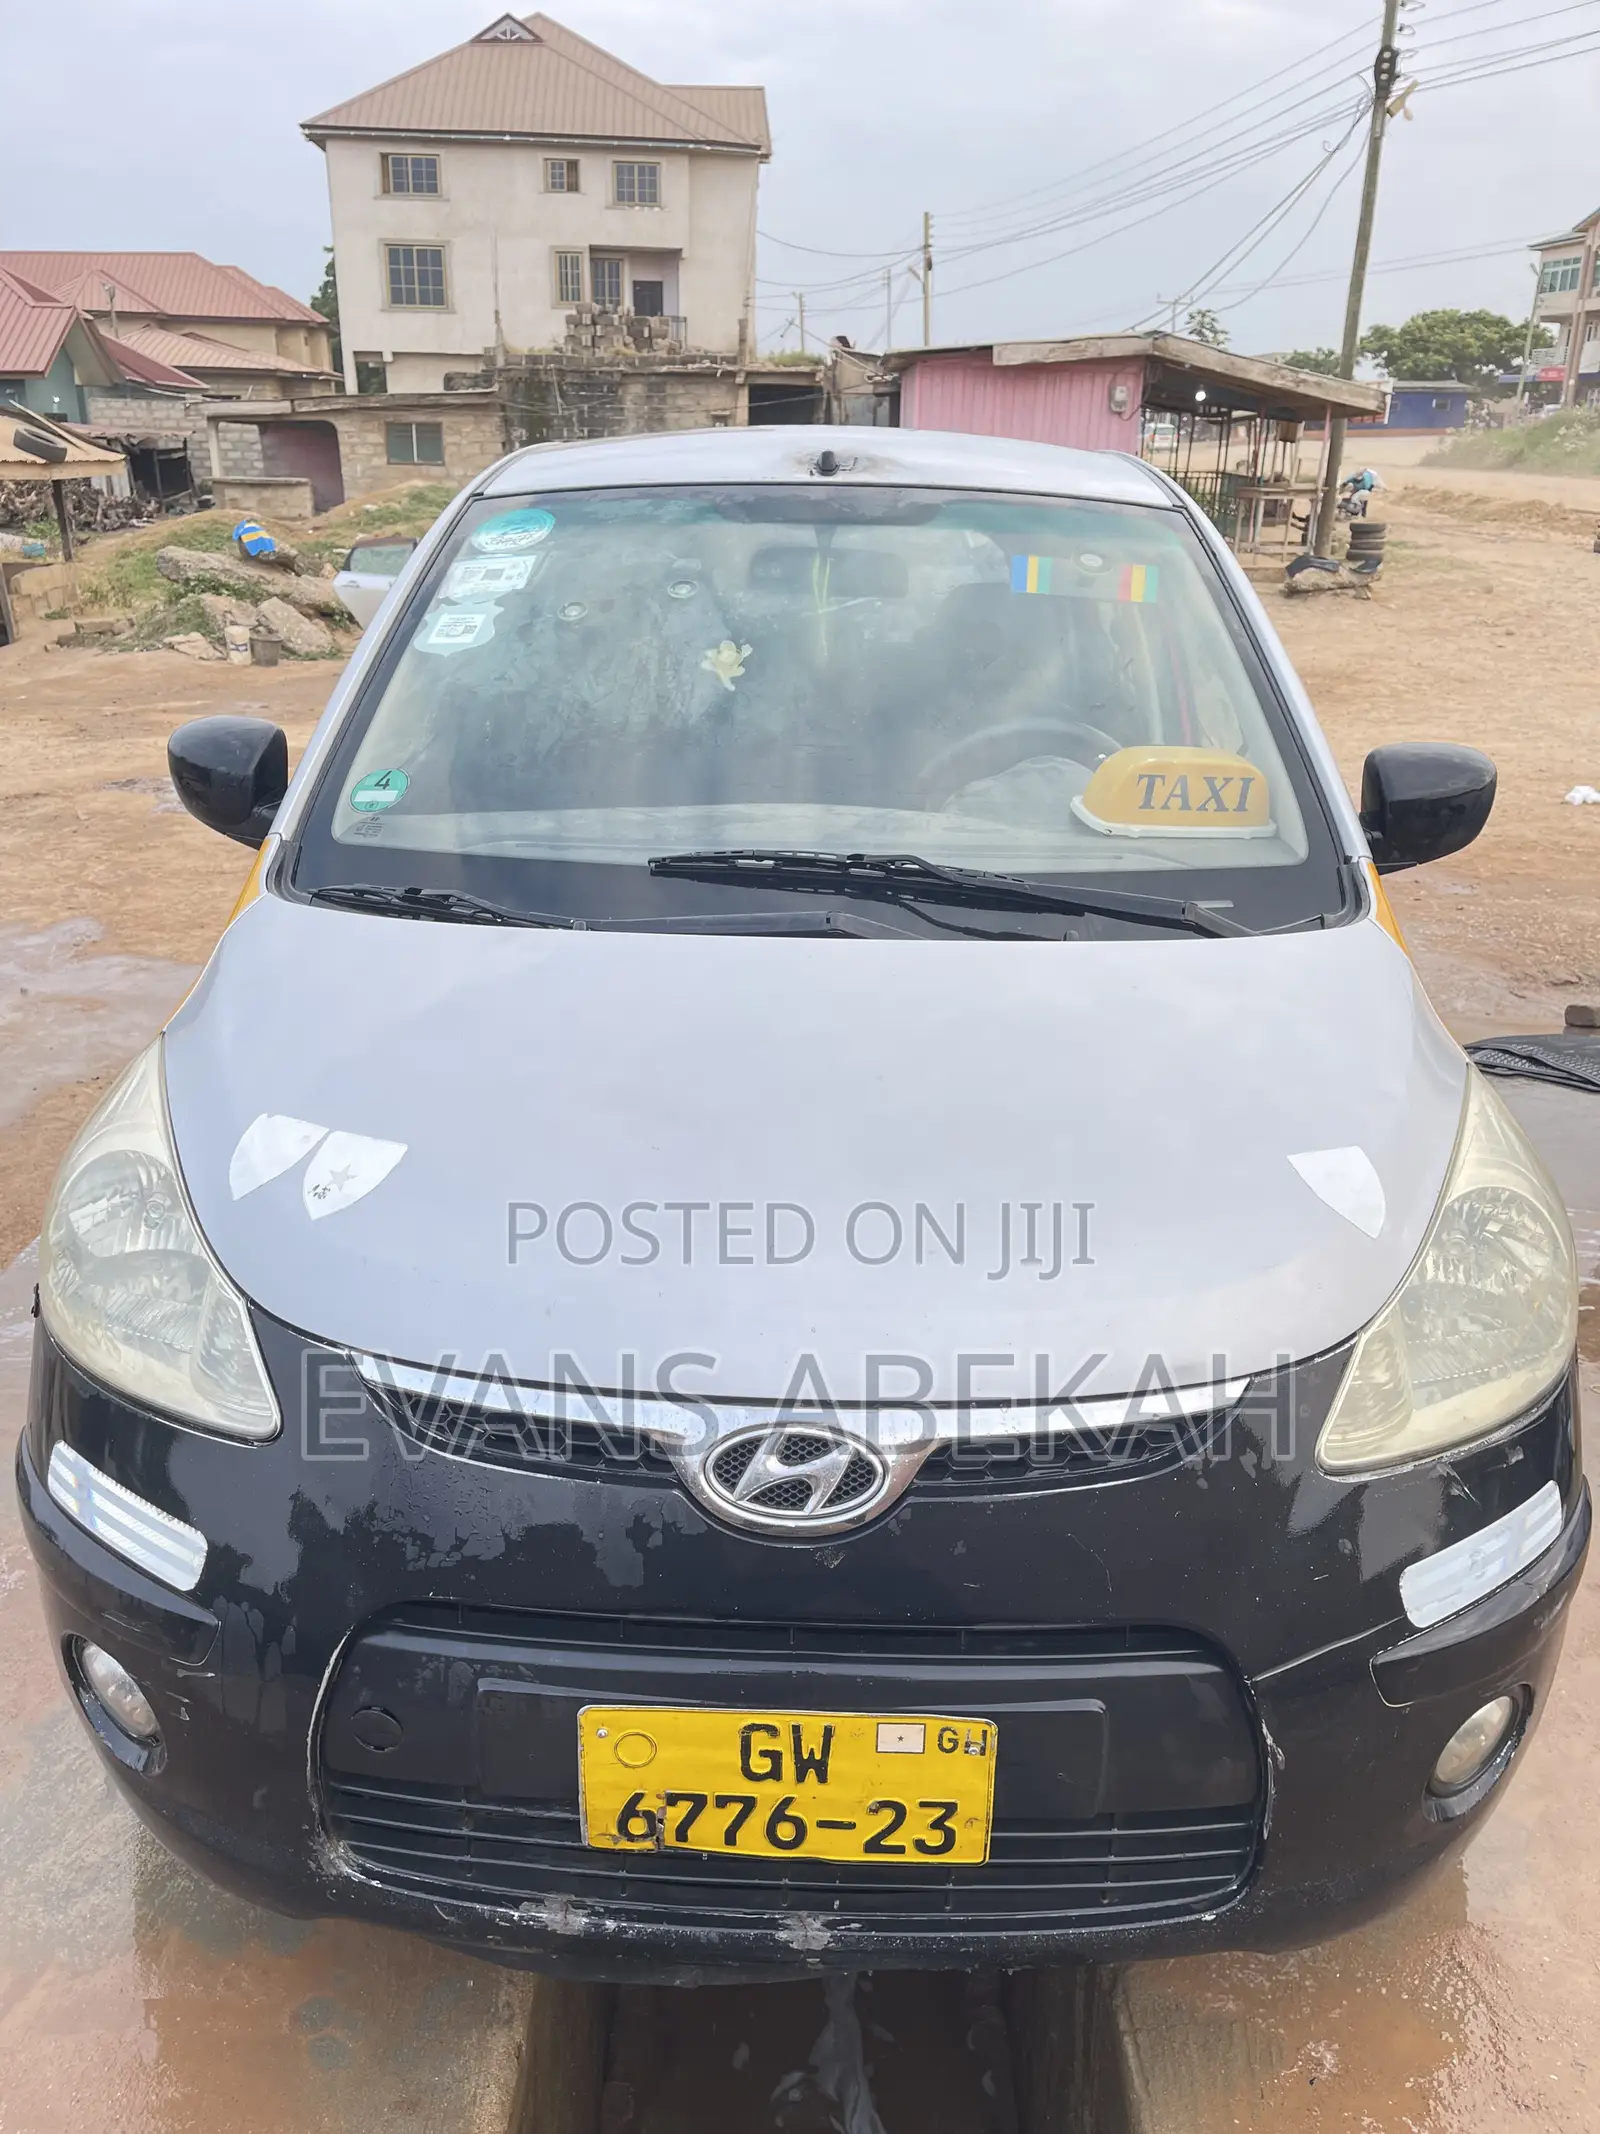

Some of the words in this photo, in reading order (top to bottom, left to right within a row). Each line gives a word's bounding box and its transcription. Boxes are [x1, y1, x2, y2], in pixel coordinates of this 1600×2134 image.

[374, 770, 392, 790] 4
[1136, 774, 1255, 812] TAXI
[738, 1722, 836, 1784] GW
[937, 1726, 988, 1757] GH
[615, 1790, 960, 1856] 6776-23
